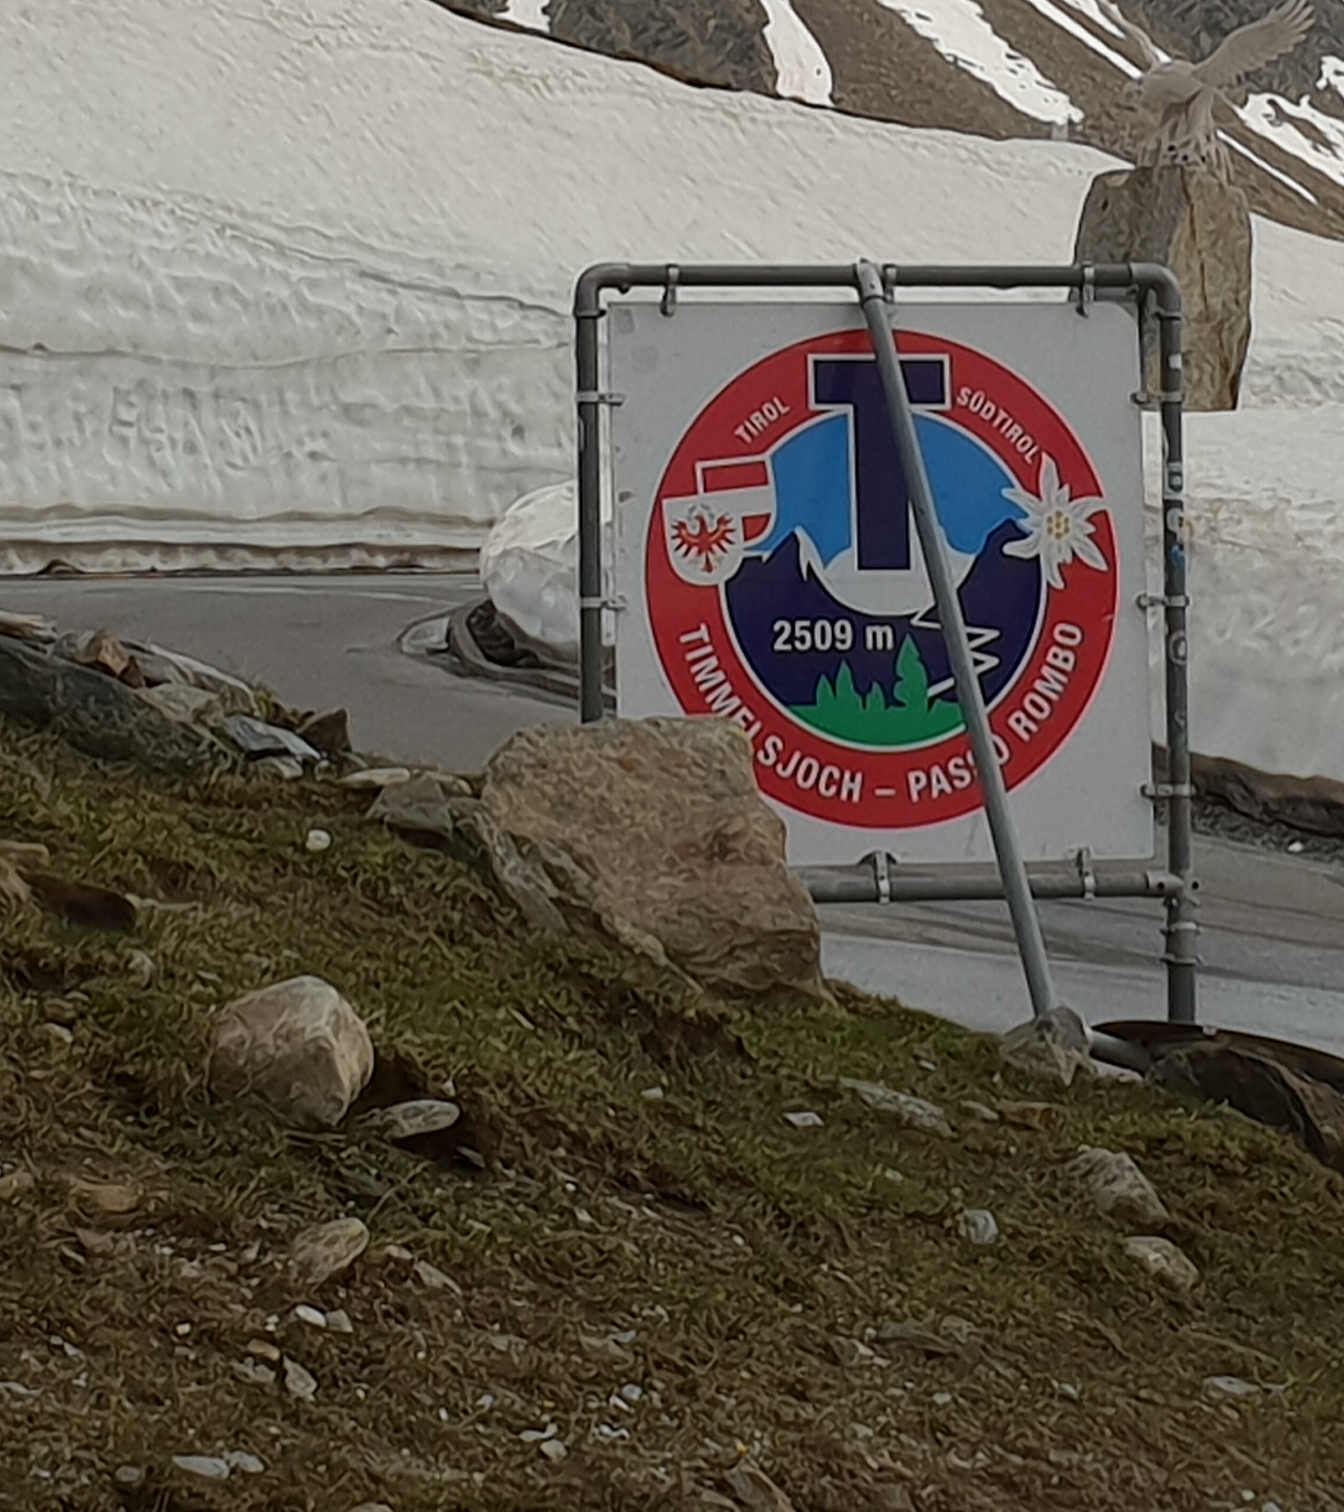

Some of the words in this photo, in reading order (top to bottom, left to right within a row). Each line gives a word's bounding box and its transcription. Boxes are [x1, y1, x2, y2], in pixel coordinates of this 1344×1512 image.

[734, 396, 791, 444] TIROL
[957, 386, 1040, 465] SÜDTIROL
[772, 619, 854, 652] 2509
[865, 624, 895, 651] m
[907, 733, 1011, 804] PASO
[1007, 622, 1083, 743] ROMBO
